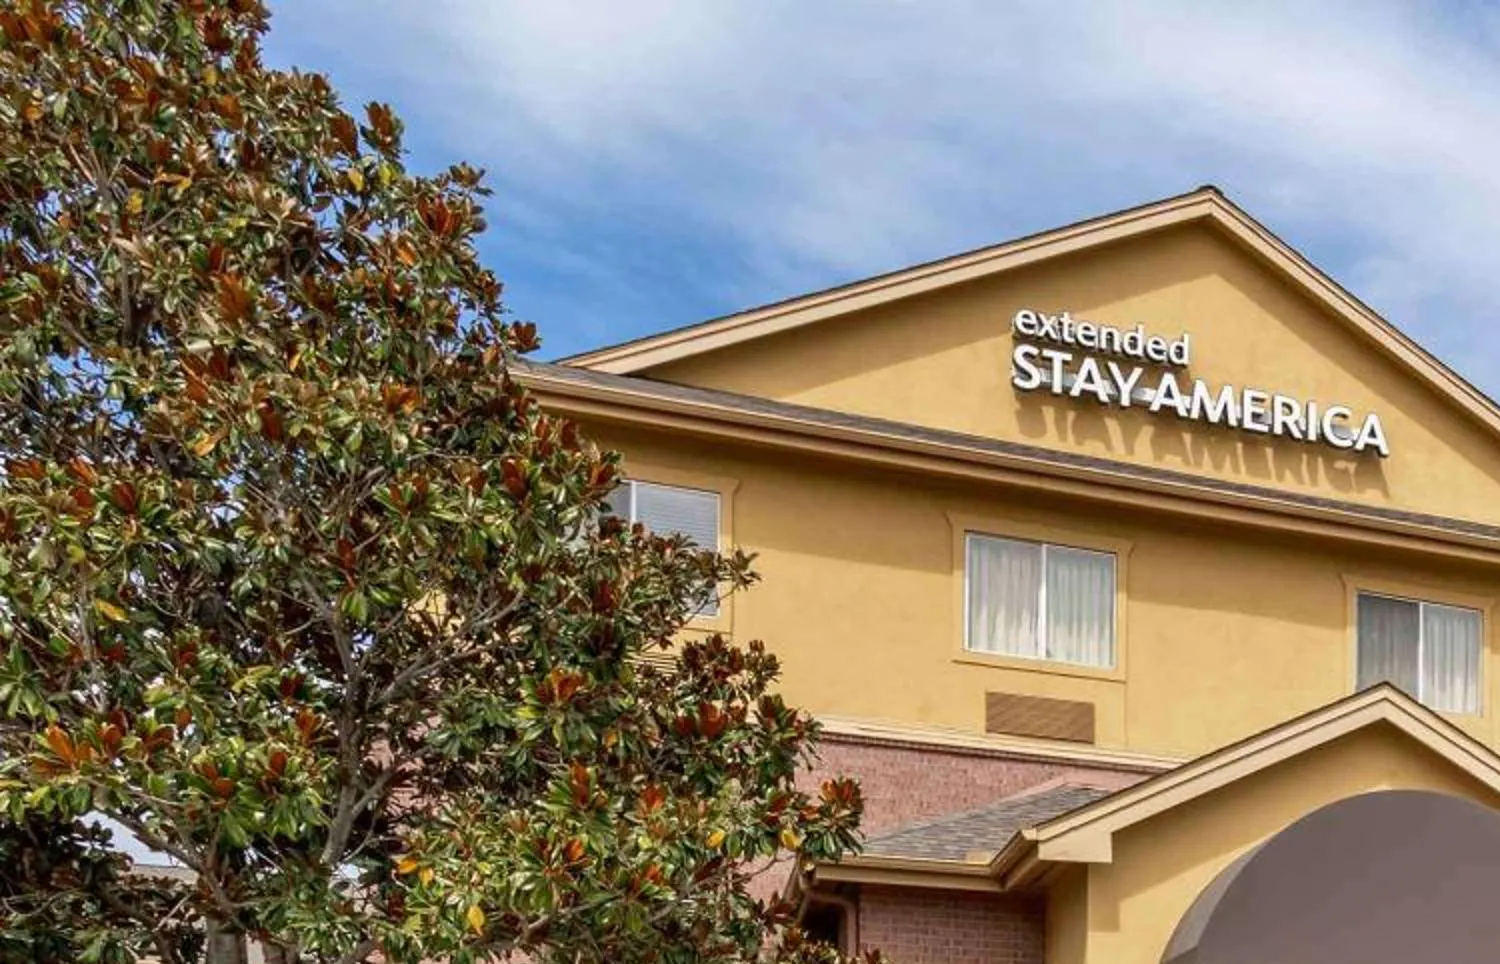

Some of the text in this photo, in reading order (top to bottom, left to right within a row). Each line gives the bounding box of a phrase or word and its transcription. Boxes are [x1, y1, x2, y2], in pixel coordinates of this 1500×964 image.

[1014, 308, 1191, 366] extended
[1012, 343, 1391, 457] STAY AMERICA
